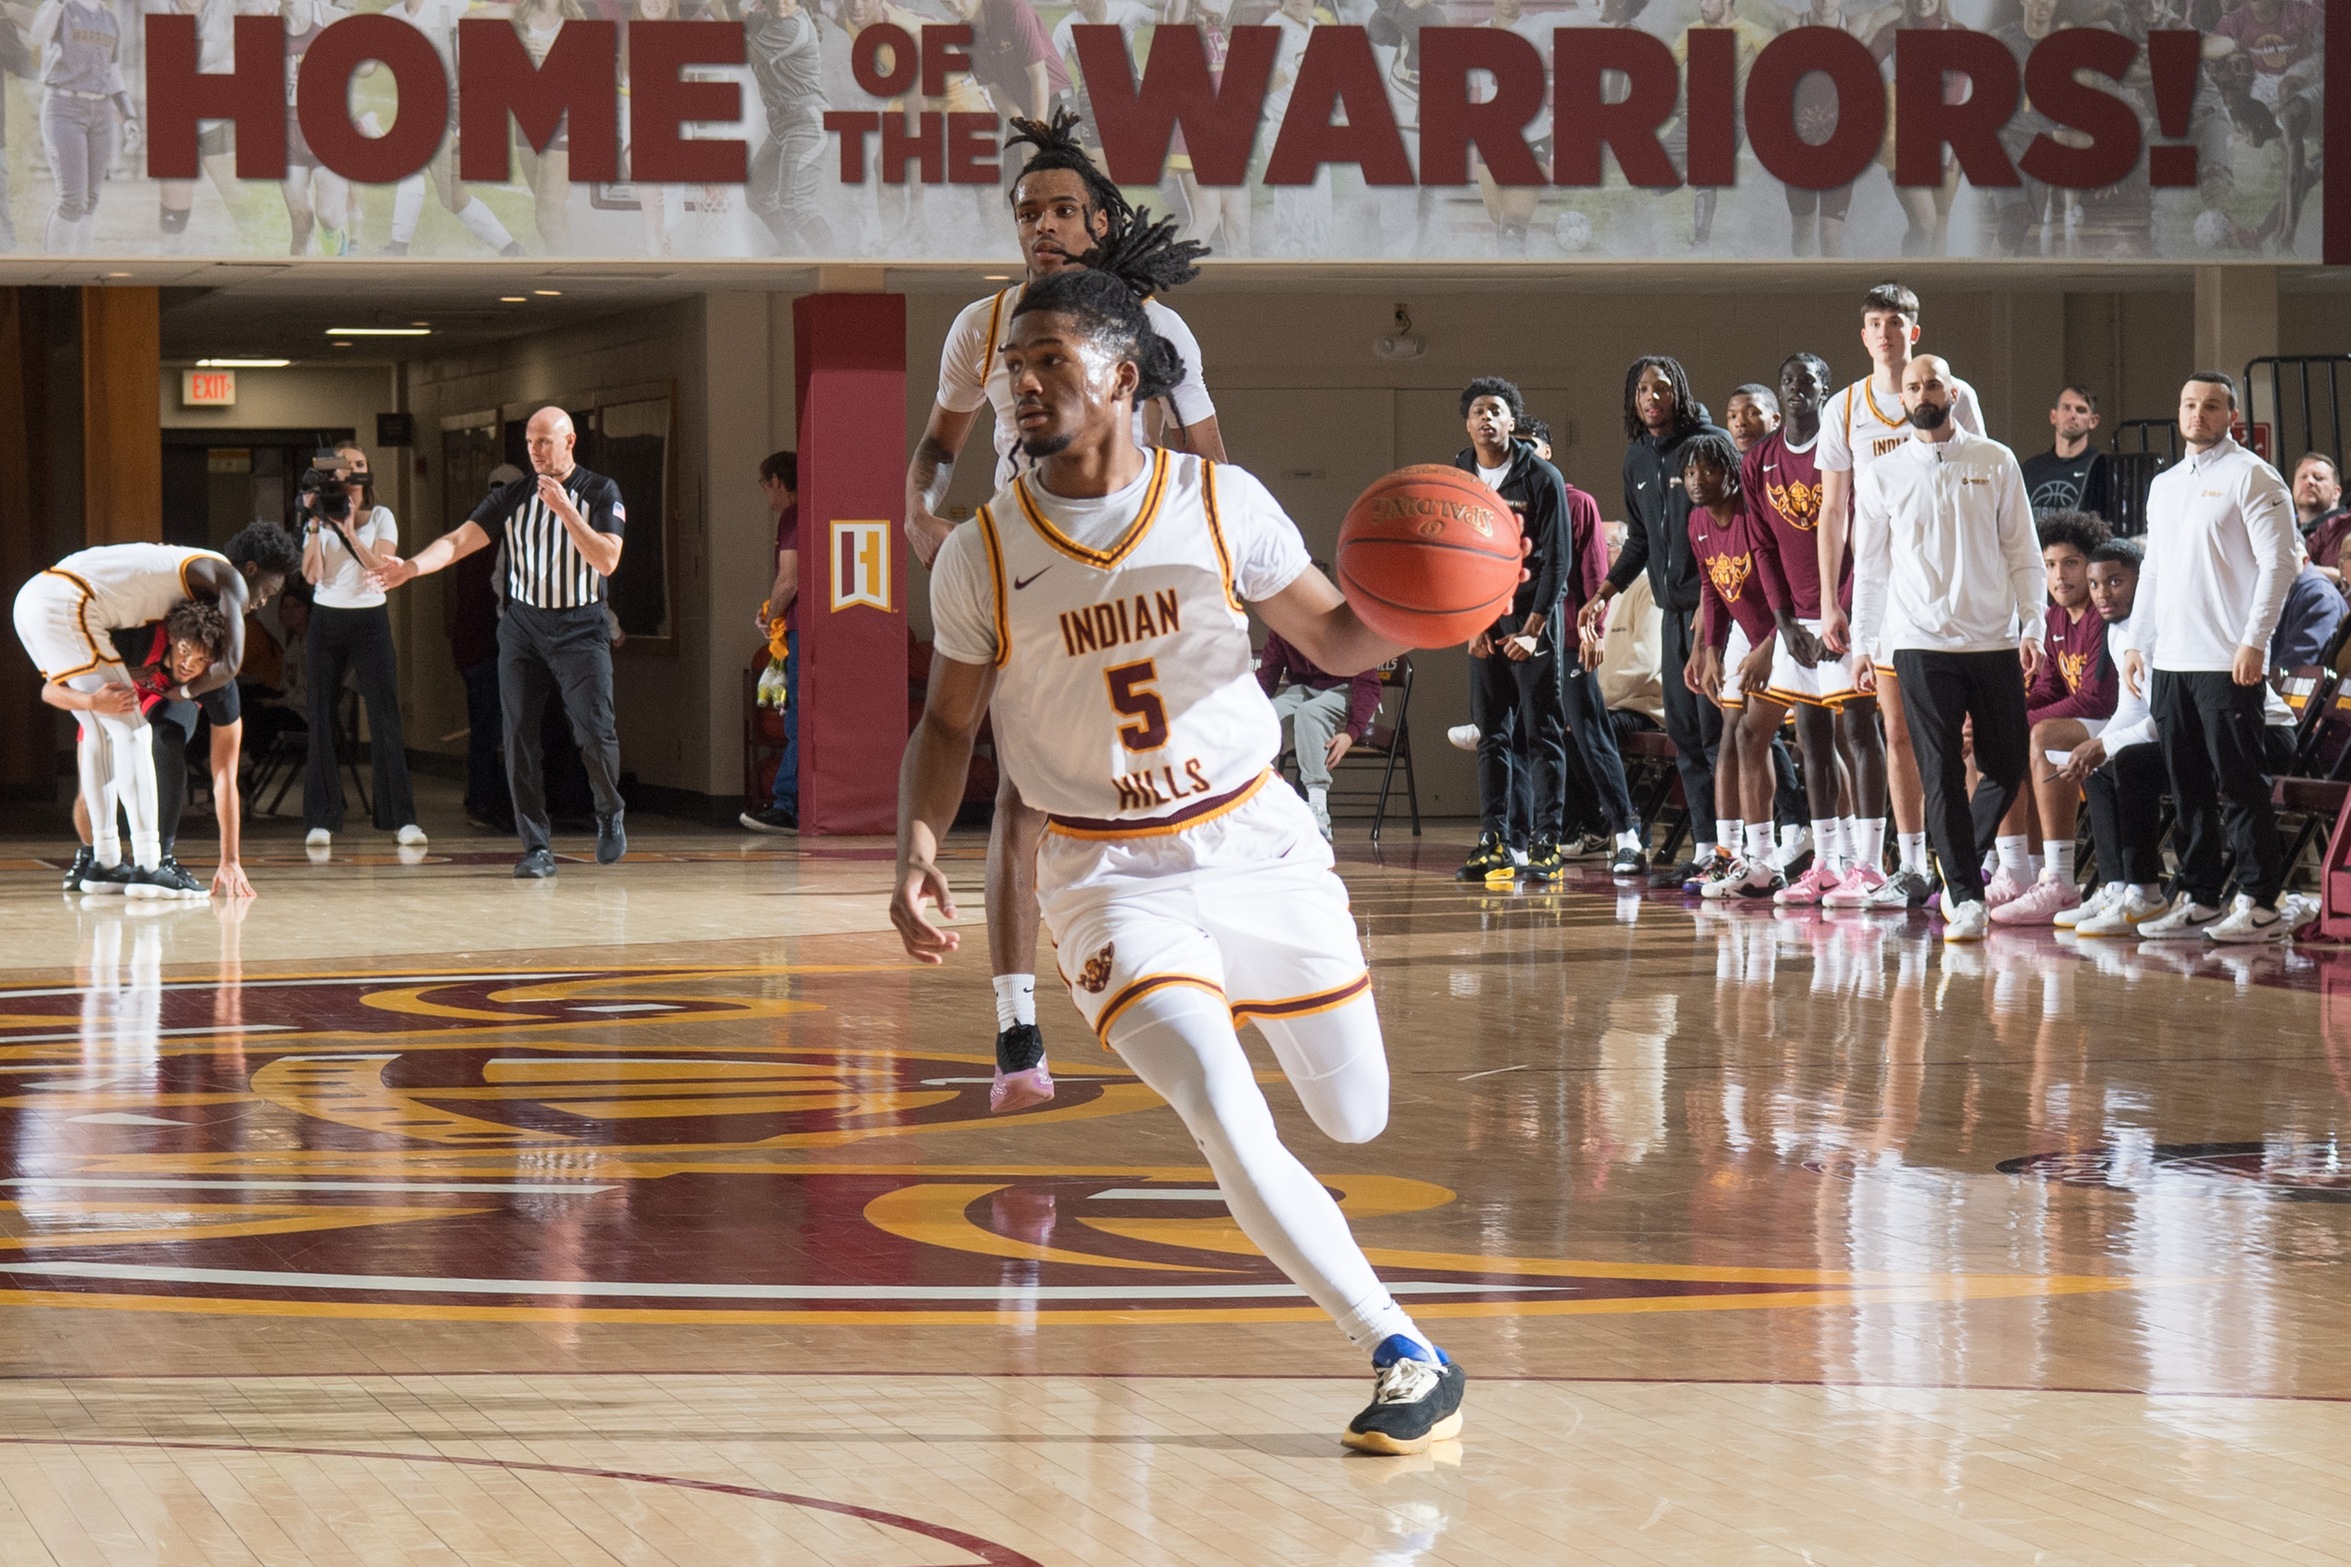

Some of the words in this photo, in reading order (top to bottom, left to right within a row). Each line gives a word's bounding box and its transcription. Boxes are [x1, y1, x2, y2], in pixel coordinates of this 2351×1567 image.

[851, 23, 972, 97] OF
[145, 13, 748, 184] HOME
[1071, 24, 2200, 189] WARRIORS!
[822, 111, 1000, 184] THE
[192, 374, 228, 399] EXIT
[1872, 436, 1909, 457] INDI
[1372, 496, 1494, 538] SPALDING
[1059, 588, 1181, 657] INDIAN
[1103, 657, 1170, 754] 5
[1112, 757, 1211, 811] HILLS
